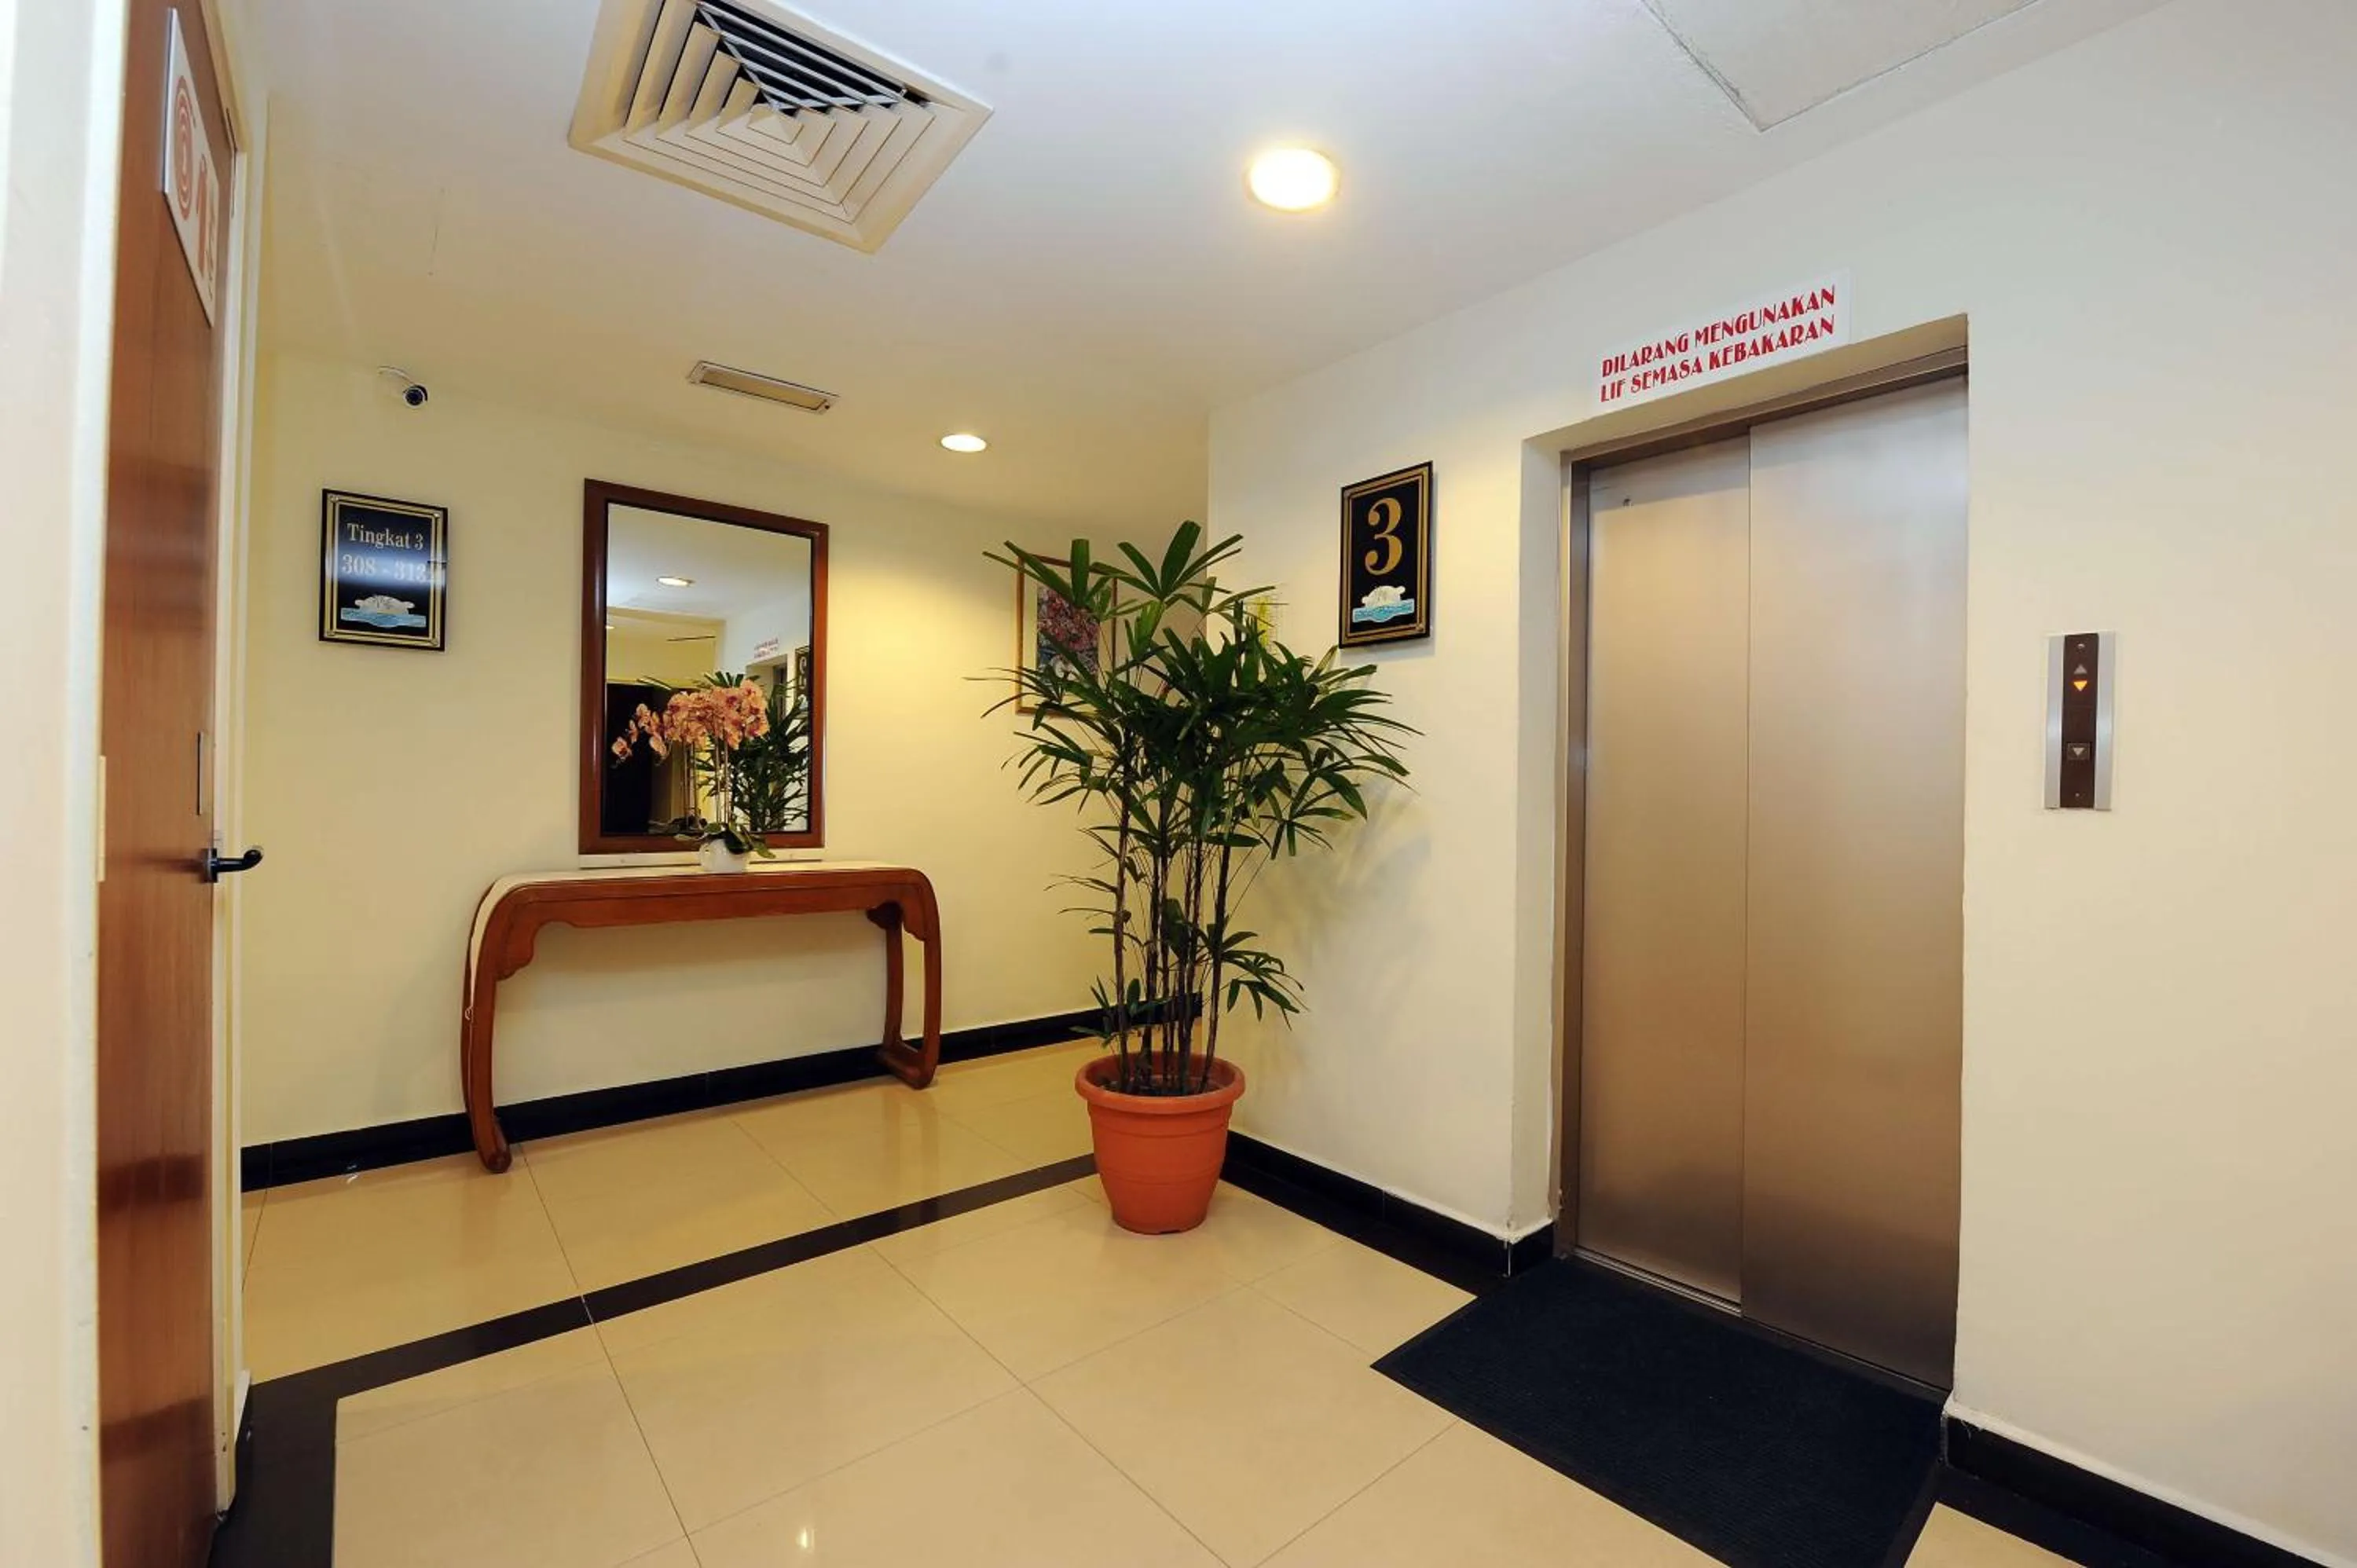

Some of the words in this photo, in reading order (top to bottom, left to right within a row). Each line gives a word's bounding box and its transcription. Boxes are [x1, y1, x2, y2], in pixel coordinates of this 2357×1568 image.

[1600, 378, 1626, 402] LIF
[1630, 356, 1703, 393] SEMASA
[1709, 314, 1835, 371] KEBAKARAN
[1603, 333, 1688, 377] DILARANG
[1695, 284, 1835, 347] MENGUNAKAN
[342, 554, 376, 575] 308
[346, 522, 411, 549] Tingkat
[414, 533, 424, 550] 3
[1365, 497, 1402, 575] 3
